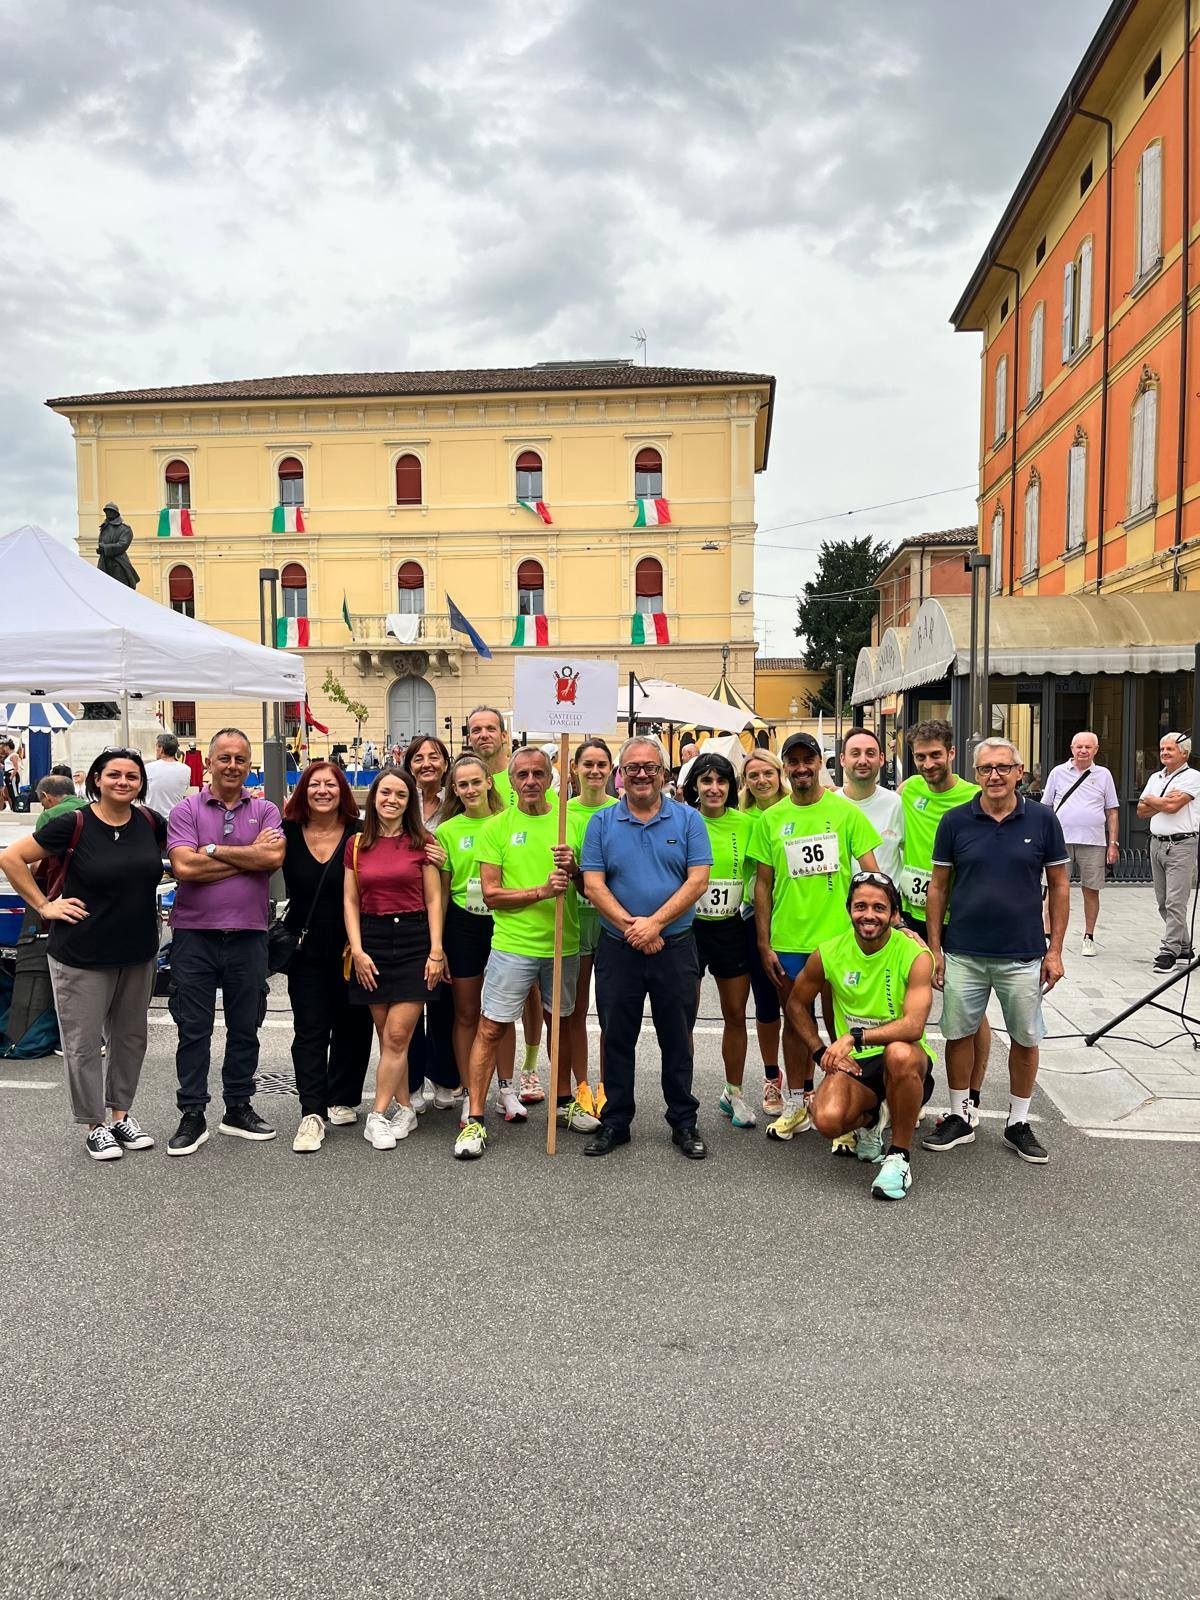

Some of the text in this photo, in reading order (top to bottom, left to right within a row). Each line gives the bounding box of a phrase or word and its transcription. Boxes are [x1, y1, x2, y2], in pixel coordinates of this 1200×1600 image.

[917, 615, 935, 652] BAR
[801, 844, 824, 864] 36
[711, 889, 729, 905] 31
[912, 877, 930, 897] 34
[885, 968, 893, 1008] CASTELLO
